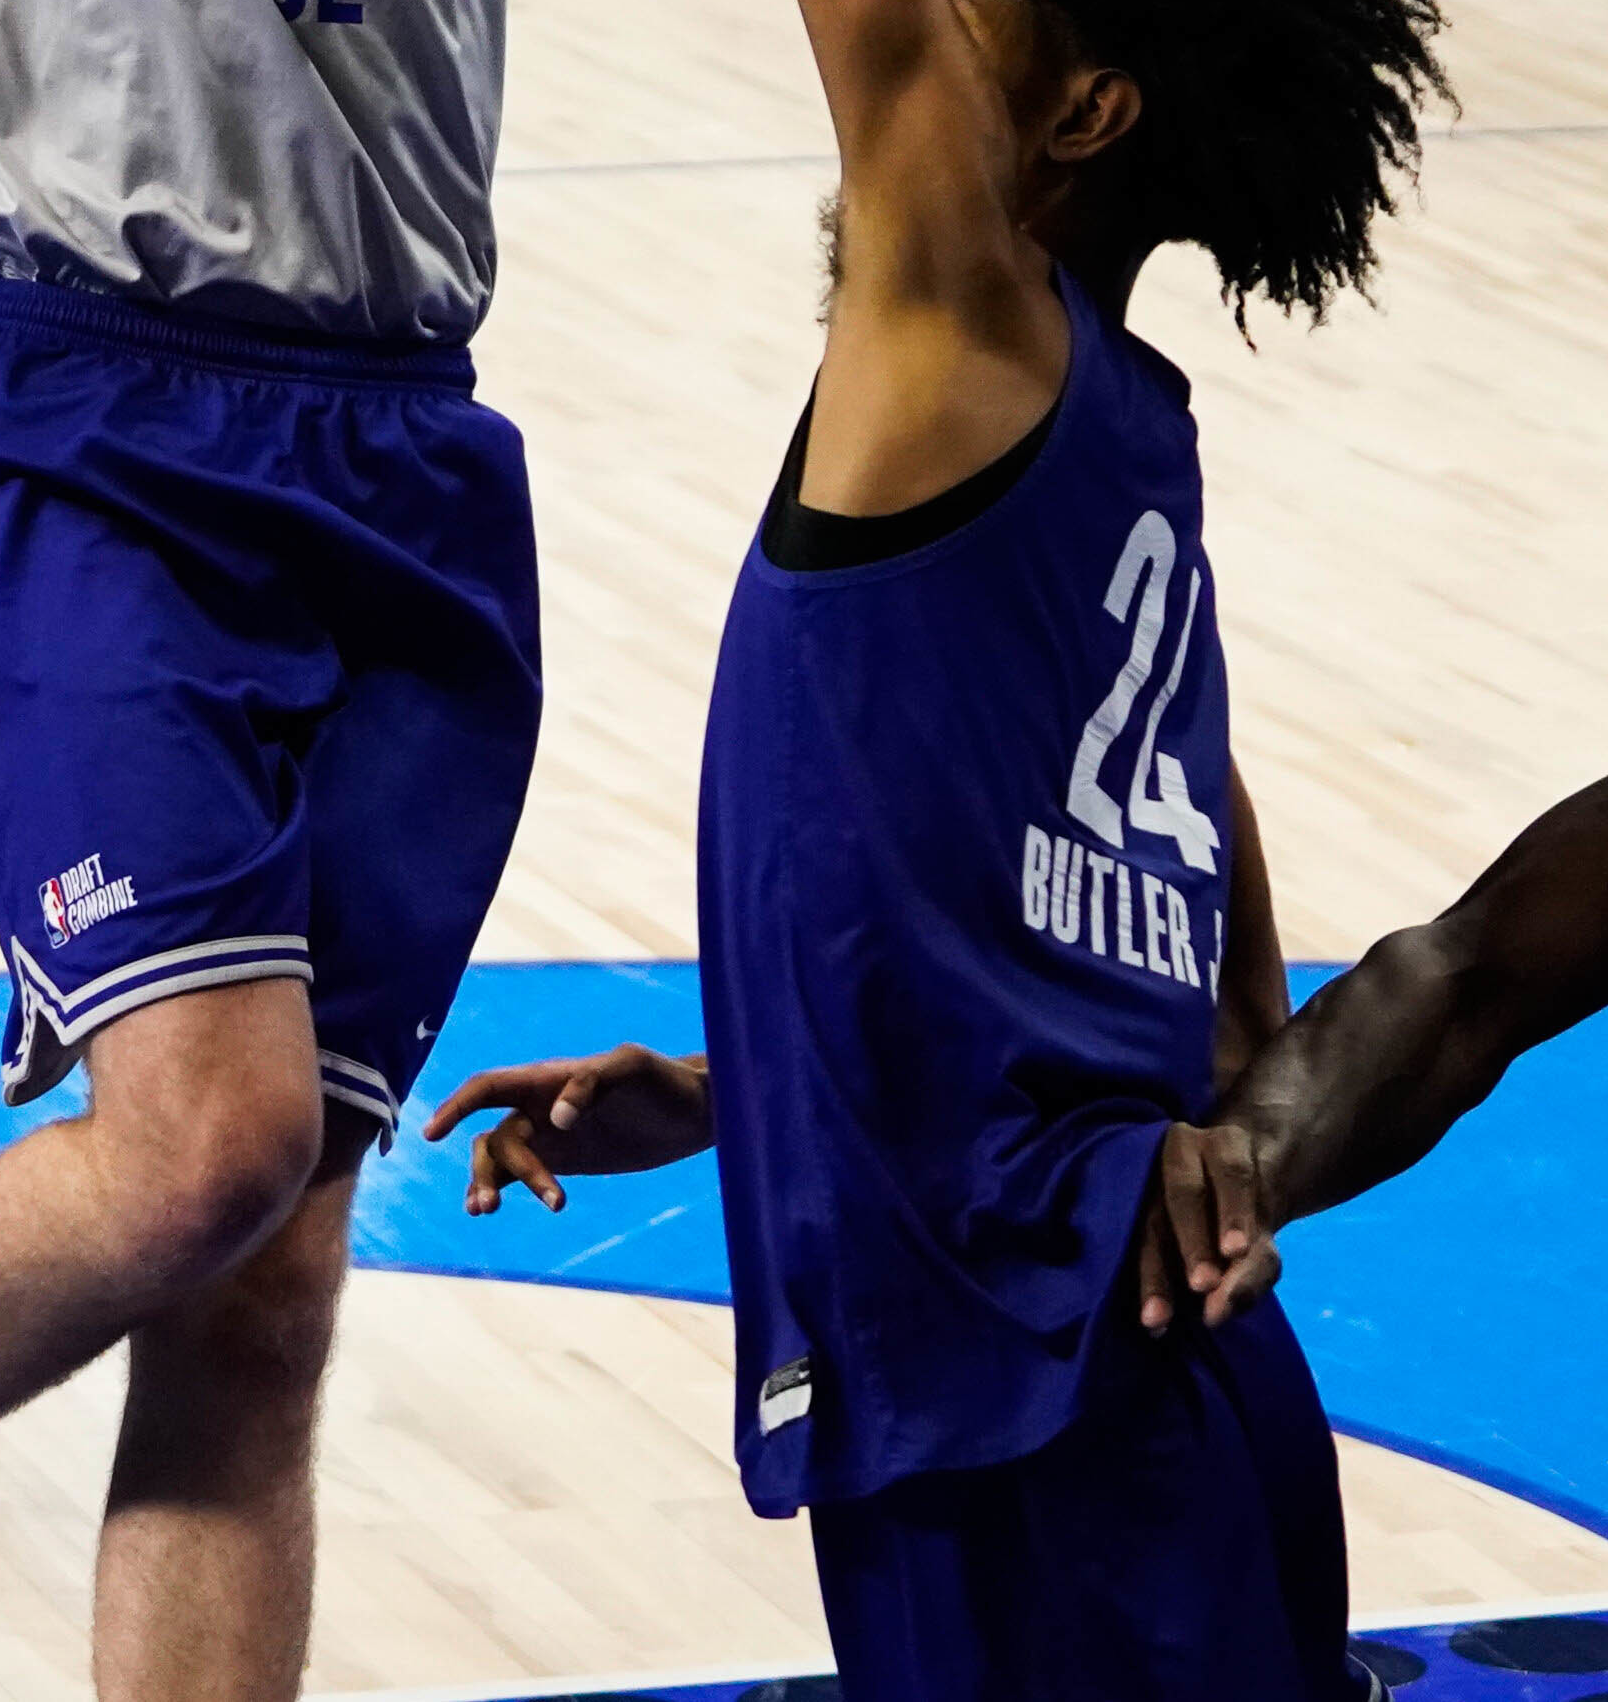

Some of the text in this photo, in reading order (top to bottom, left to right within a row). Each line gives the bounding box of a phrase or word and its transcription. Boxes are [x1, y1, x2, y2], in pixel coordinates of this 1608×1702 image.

[1066, 509, 1221, 875] 24
[60, 853, 105, 905] DRAFT
[67, 875, 138, 935] COMBINE
[1021, 823, 1202, 990] BUTLER
